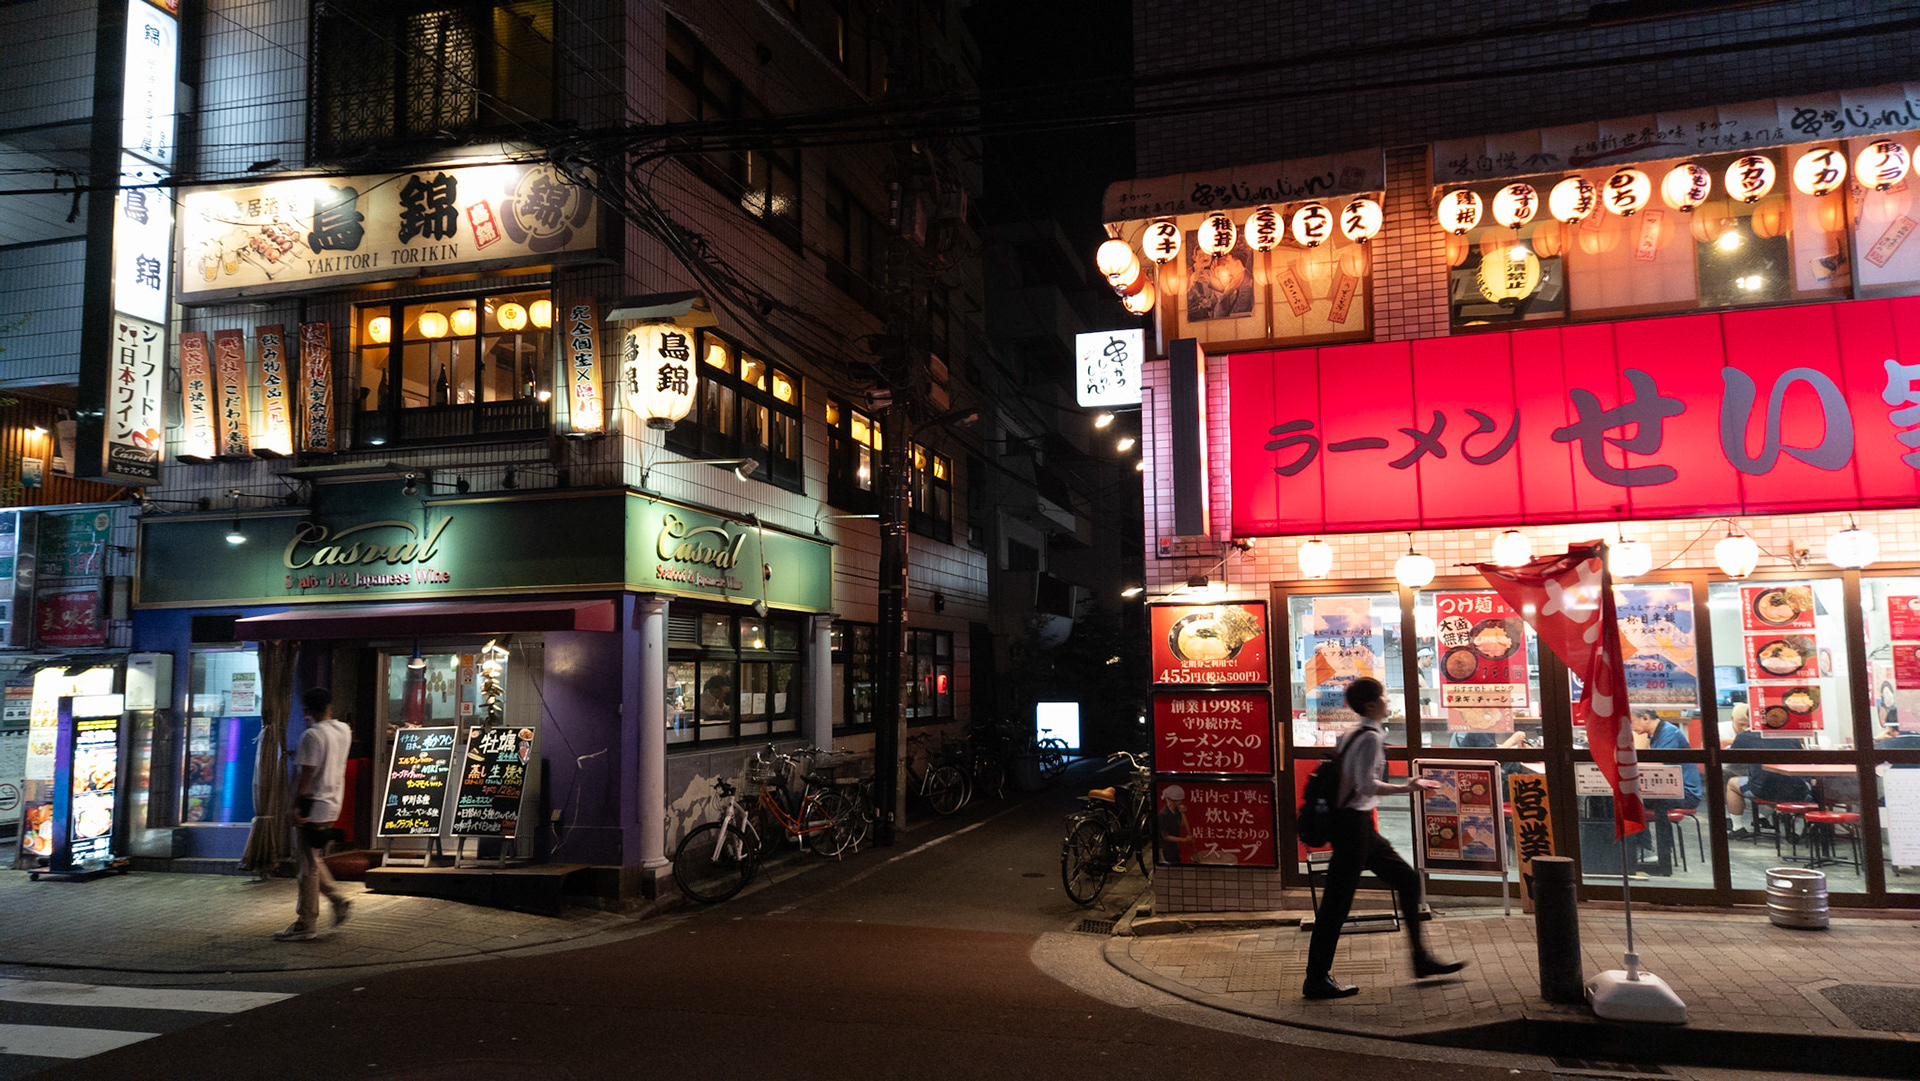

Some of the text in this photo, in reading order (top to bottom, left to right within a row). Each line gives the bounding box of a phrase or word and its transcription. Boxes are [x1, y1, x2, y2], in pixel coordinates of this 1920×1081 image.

[1448, 152, 1519, 176] 味自慢
[1812, 151, 1839, 185] イカ
[307, 171, 459, 255] 鳥錦
[1303, 206, 1327, 238] エビ
[1346, 201, 1366, 234] キス
[1156, 223, 1177, 254] カキ
[307, 243, 459, 275] YAKITORI TORIKIN
[656, 331, 690, 397] 鳥錦
[117, 346, 136, 440] 日本ワイン
[1263, 408, 1520, 477] ラーメン
[282, 515, 454, 570] Casval
[656, 512, 747, 569] Casval
[338, 572, 350, 587] &
[352, 571, 411, 589] Japanese
[414, 568, 450, 586] Wine
[1438, 596, 1494, 615] つけ麺
[1439, 617, 1470, 633] 大盛
[1442, 630, 1472, 646] 無料
[1170, 699, 1254, 715] 創業1998年
[1182, 716, 1243, 731] 守り続けた
[479, 729, 518, 754] 牡蠣
[1164, 732, 1262, 749] ラーメンへの
[1182, 750, 1245, 769] こだわり
[1190, 788, 1270, 805] 店内で丁寧に
[1205, 807, 1255, 825] 炊いた
[1190, 826, 1270, 840] 店主こだわりの
[1513, 778, 1552, 900] 営業
[1203, 840, 1263, 862] スープ
